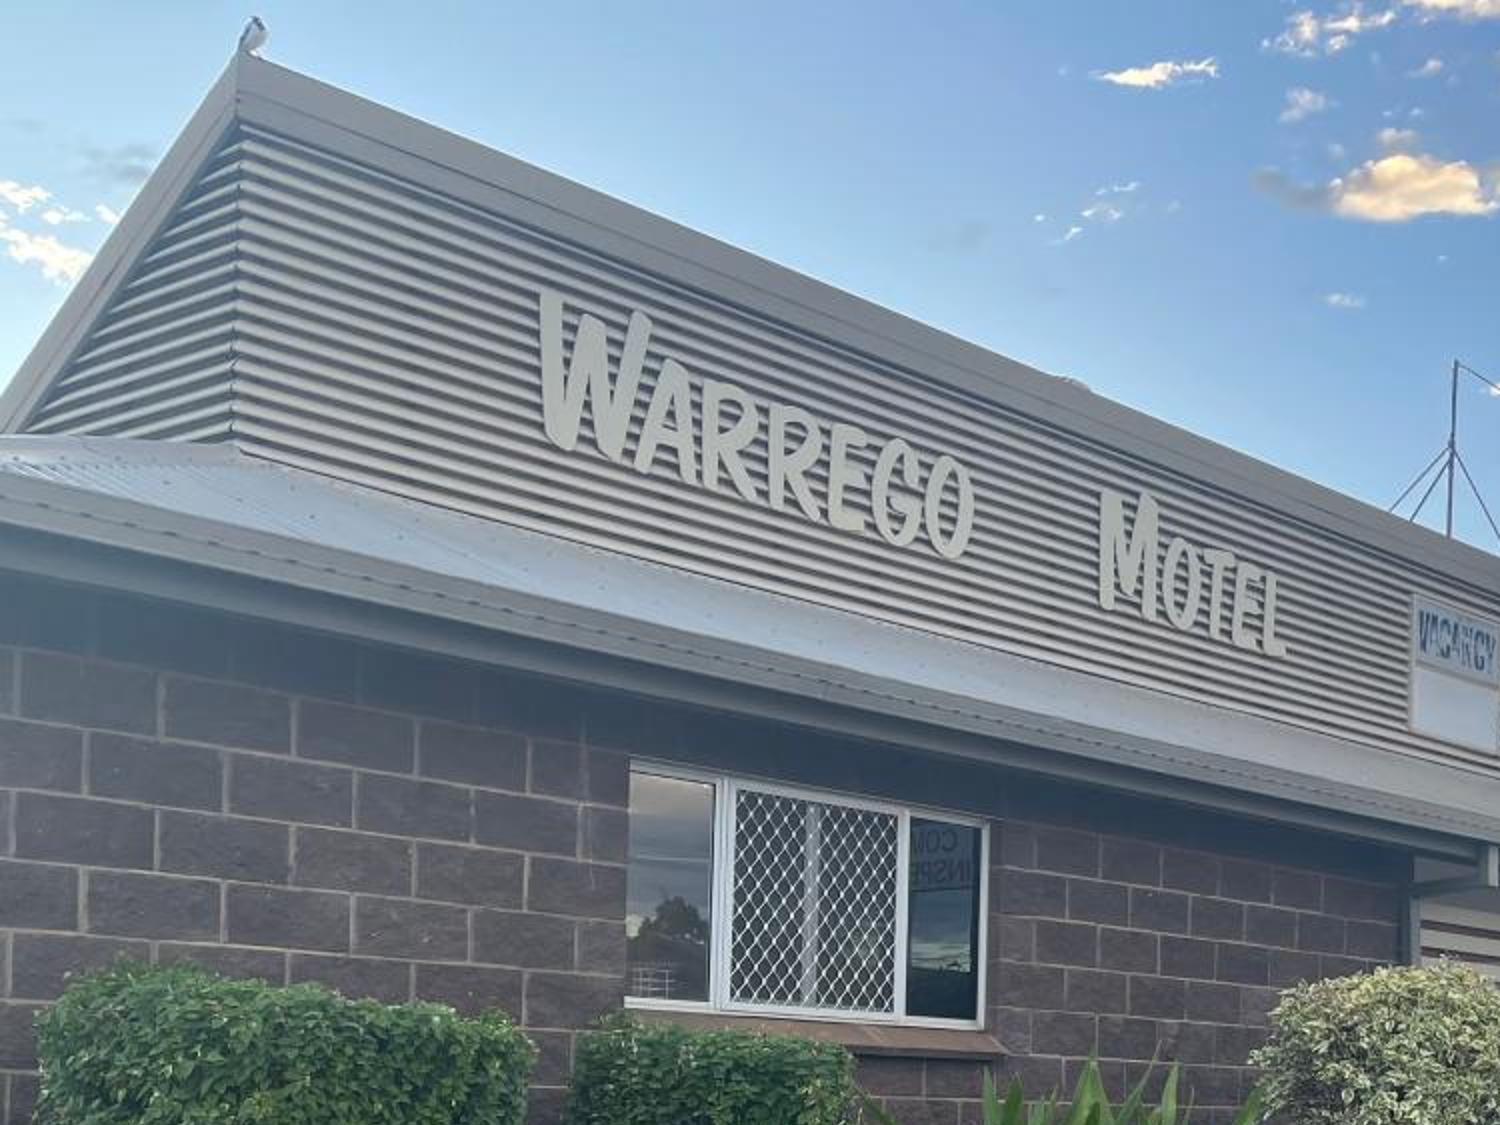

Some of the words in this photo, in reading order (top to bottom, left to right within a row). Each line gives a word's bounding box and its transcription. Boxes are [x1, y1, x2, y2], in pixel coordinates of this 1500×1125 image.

[539, 289, 975, 560] WARREGO
[1099, 489, 1287, 658] MOTEL
[1418, 609, 1497, 675] VACANCY
